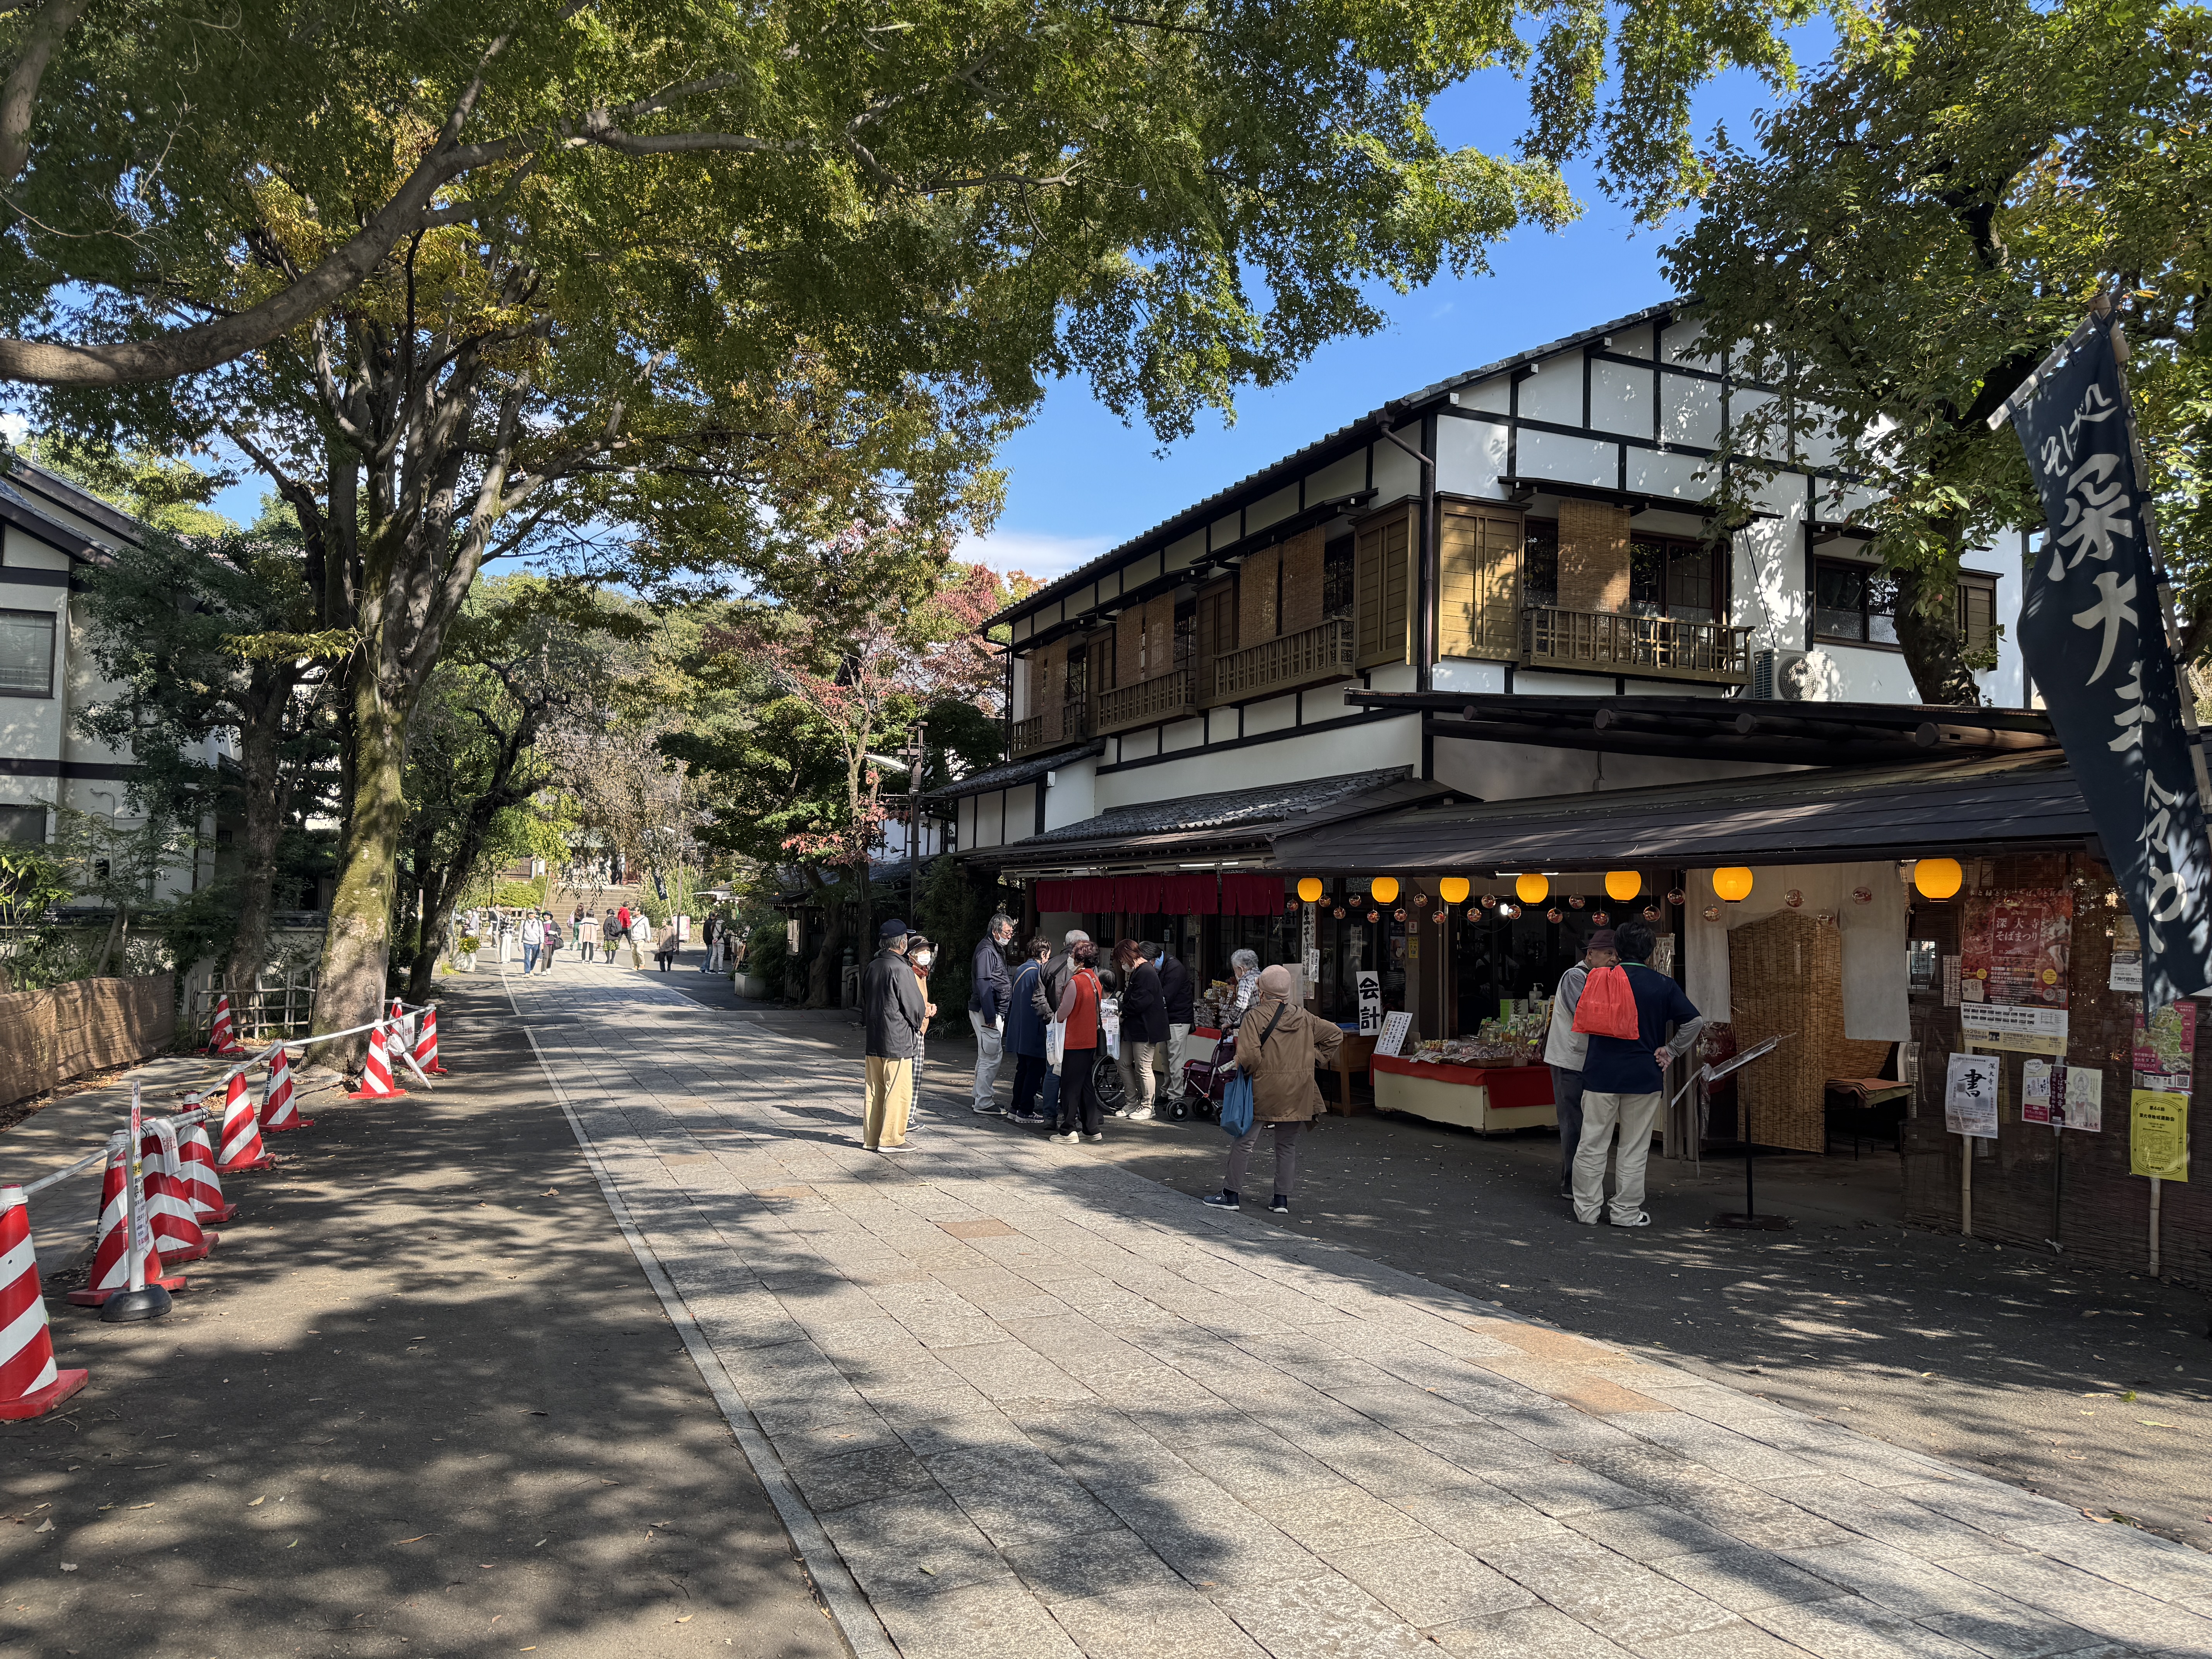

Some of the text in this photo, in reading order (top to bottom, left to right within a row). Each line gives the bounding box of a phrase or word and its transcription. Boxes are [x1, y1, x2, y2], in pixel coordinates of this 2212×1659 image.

[1996, 917, 2040, 929] 深大寺
[1996, 931, 2037, 942] そばまつり
[1359, 977, 1380, 1029] 会計
[1958, 1069, 1987, 1097] 書
